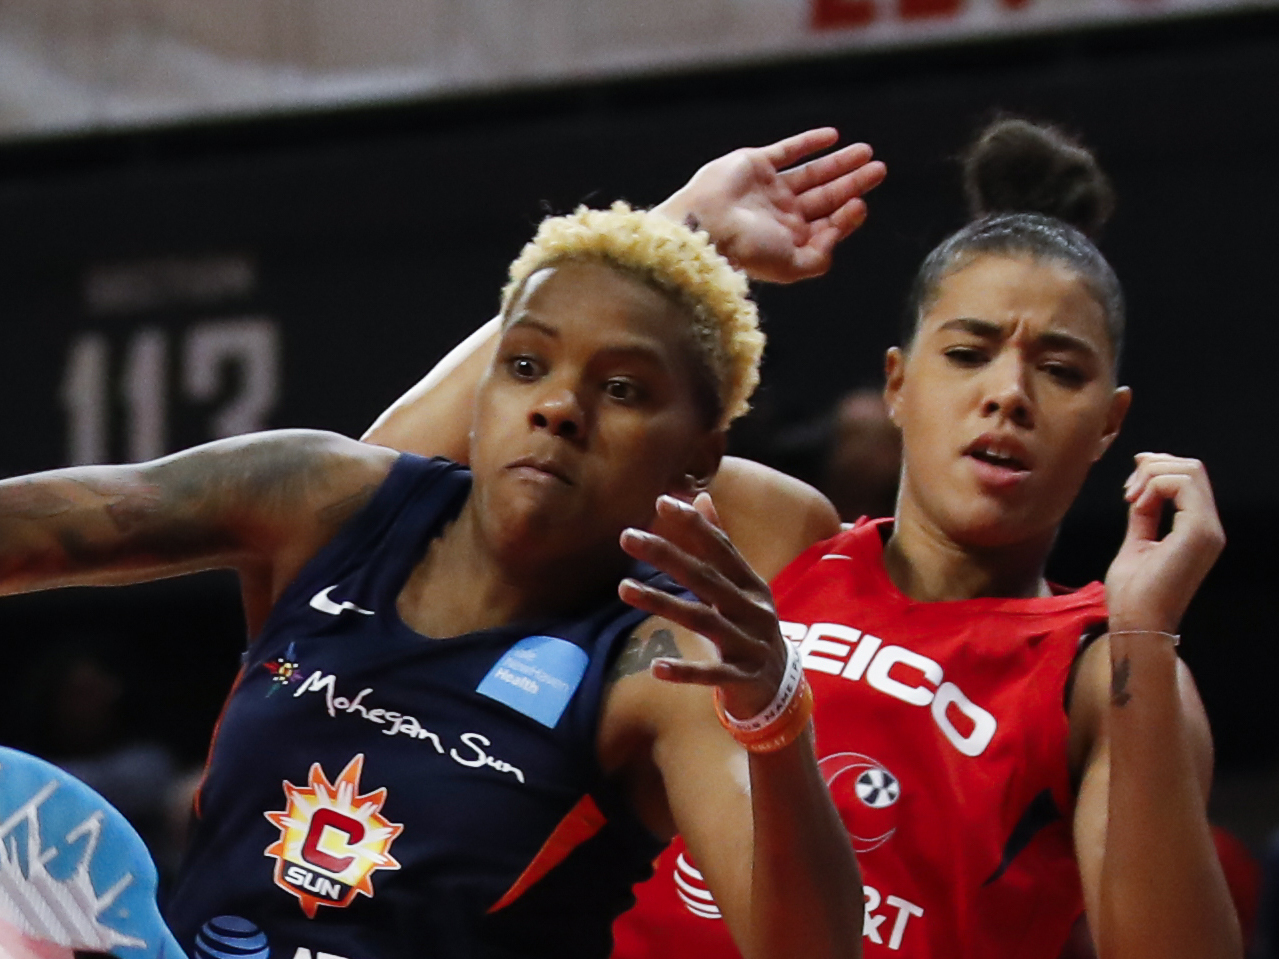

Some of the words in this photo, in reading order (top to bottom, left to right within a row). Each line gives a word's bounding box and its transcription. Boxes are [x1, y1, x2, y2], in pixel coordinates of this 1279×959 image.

[293, 670, 445, 754] Mohegan
[450, 732, 526, 784] Sun
[284, 865, 341, 900] SUN
